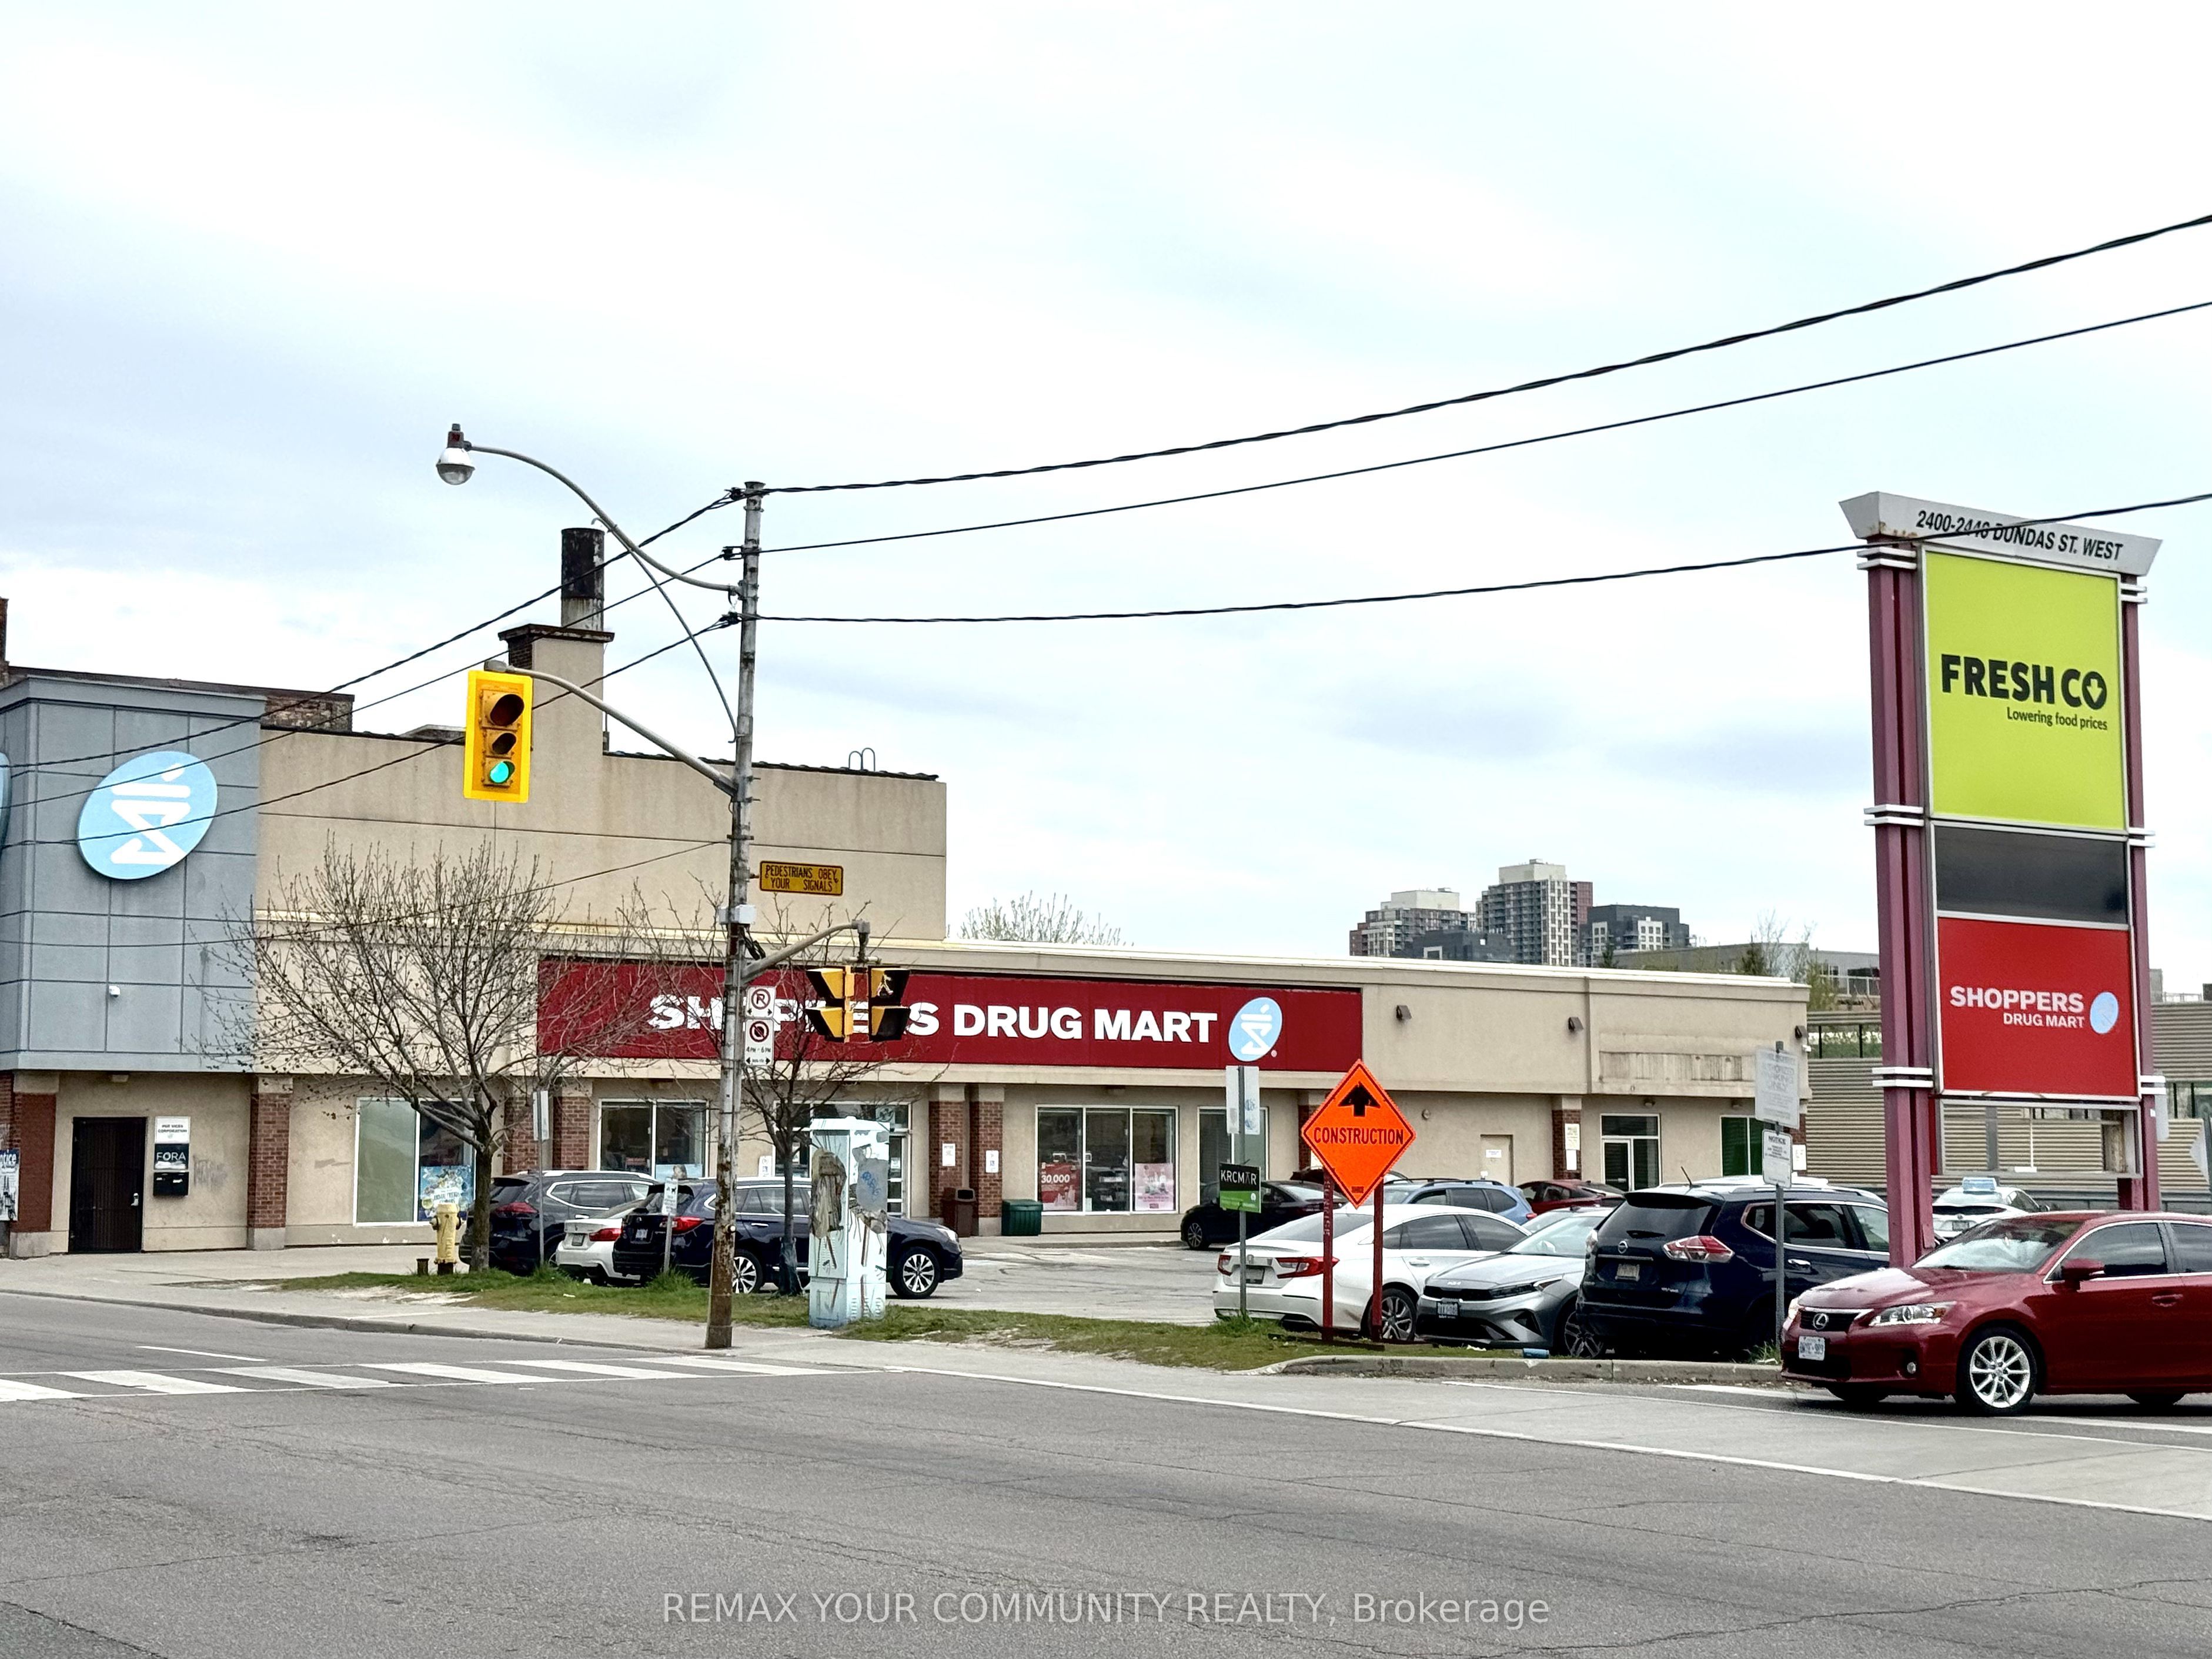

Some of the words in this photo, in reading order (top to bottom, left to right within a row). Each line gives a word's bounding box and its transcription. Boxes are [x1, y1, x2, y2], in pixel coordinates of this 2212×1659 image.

[1993, 523, 2055, 550] DUNDAS
[2058, 534, 2077, 554] ST.
[2083, 537, 2123, 560] WEST
[2007, 707, 2053, 727] Lowering
[2055, 712, 2077, 727] food
[2080, 715, 2107, 731] prices
[765, 864, 813, 879] PEDESTRIANS
[818, 868, 838, 882] OBEY
[770, 877, 790, 889] YOUR
[803, 879, 833, 892] SIGNALS
[1950, 985, 2084, 1013] SHOPPERS
[954, 1004, 1082, 1039] DRUG
[1094, 1008, 1218, 1043] MART
[2003, 1012, 2043, 1026] DRUG
[2046, 1015, 2084, 1028] MART
[1314, 1127, 1404, 1145] CONSTRUCTION
[156, 1152, 186, 1161] FORA
[1041, 1174, 1070, 1184] 30,000
